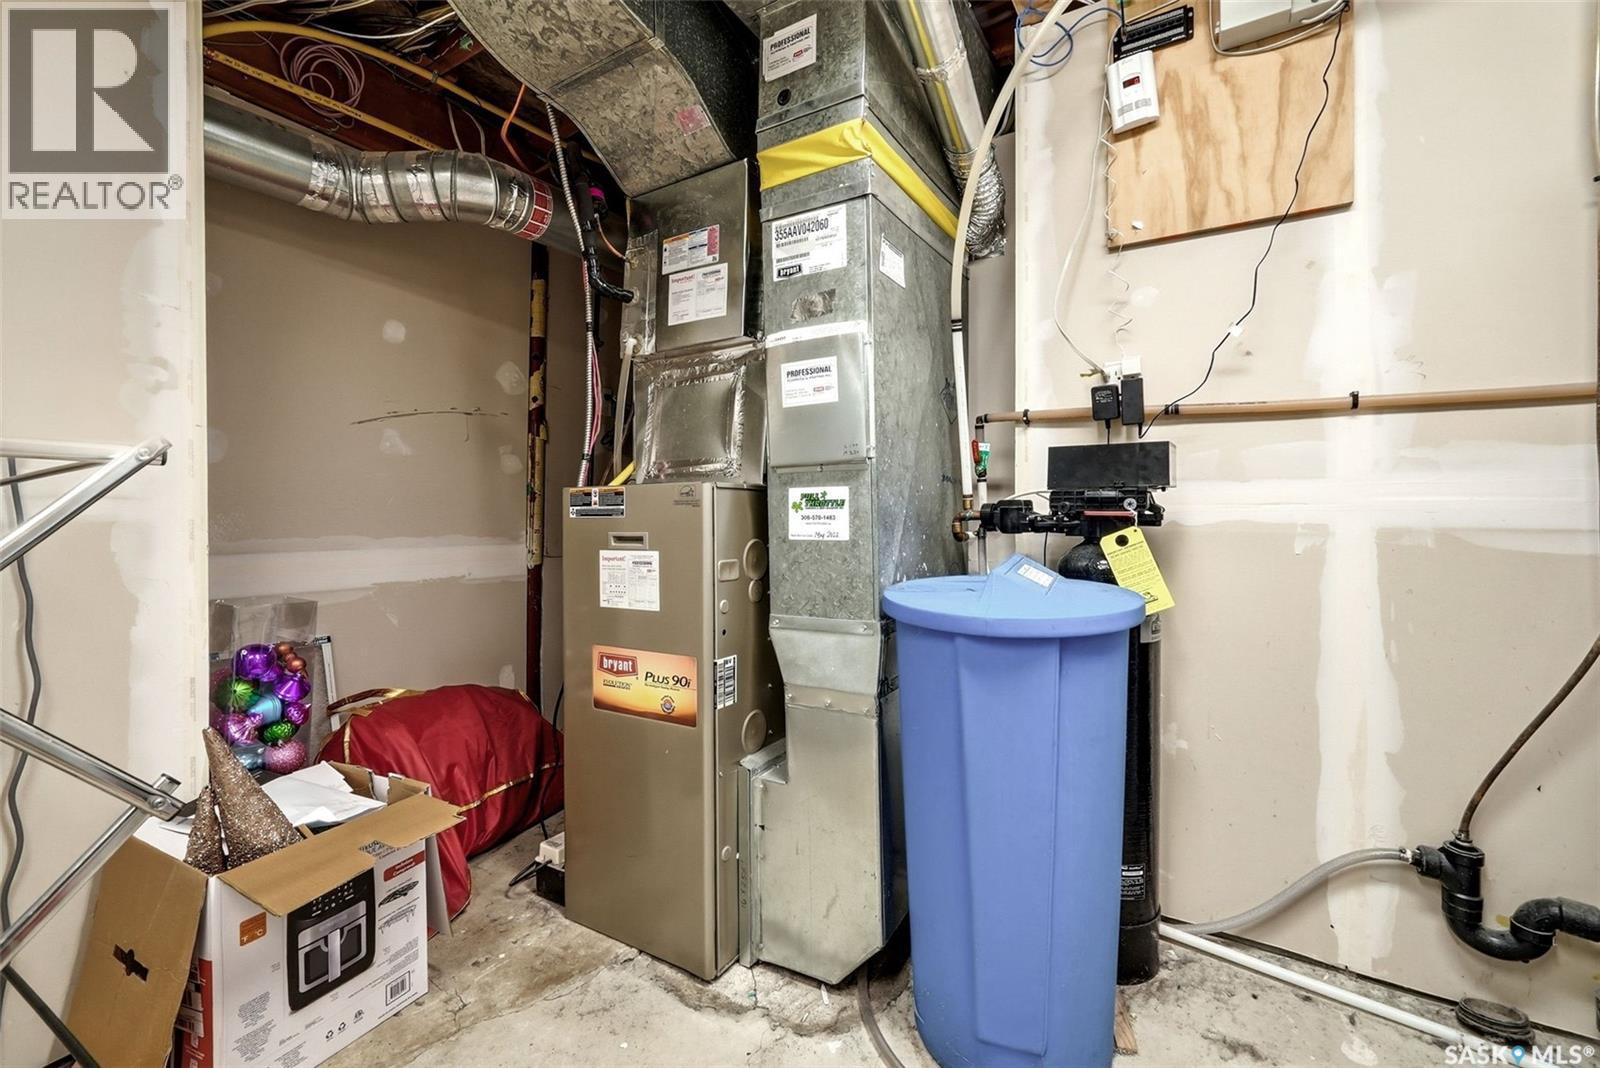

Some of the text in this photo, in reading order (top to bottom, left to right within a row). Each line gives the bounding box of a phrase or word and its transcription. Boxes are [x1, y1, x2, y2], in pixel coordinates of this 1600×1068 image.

[786, 365, 832, 379] PROFESSIONAL
[602, 656, 633, 673] bryant
[671, 675, 692, 689] 90i
